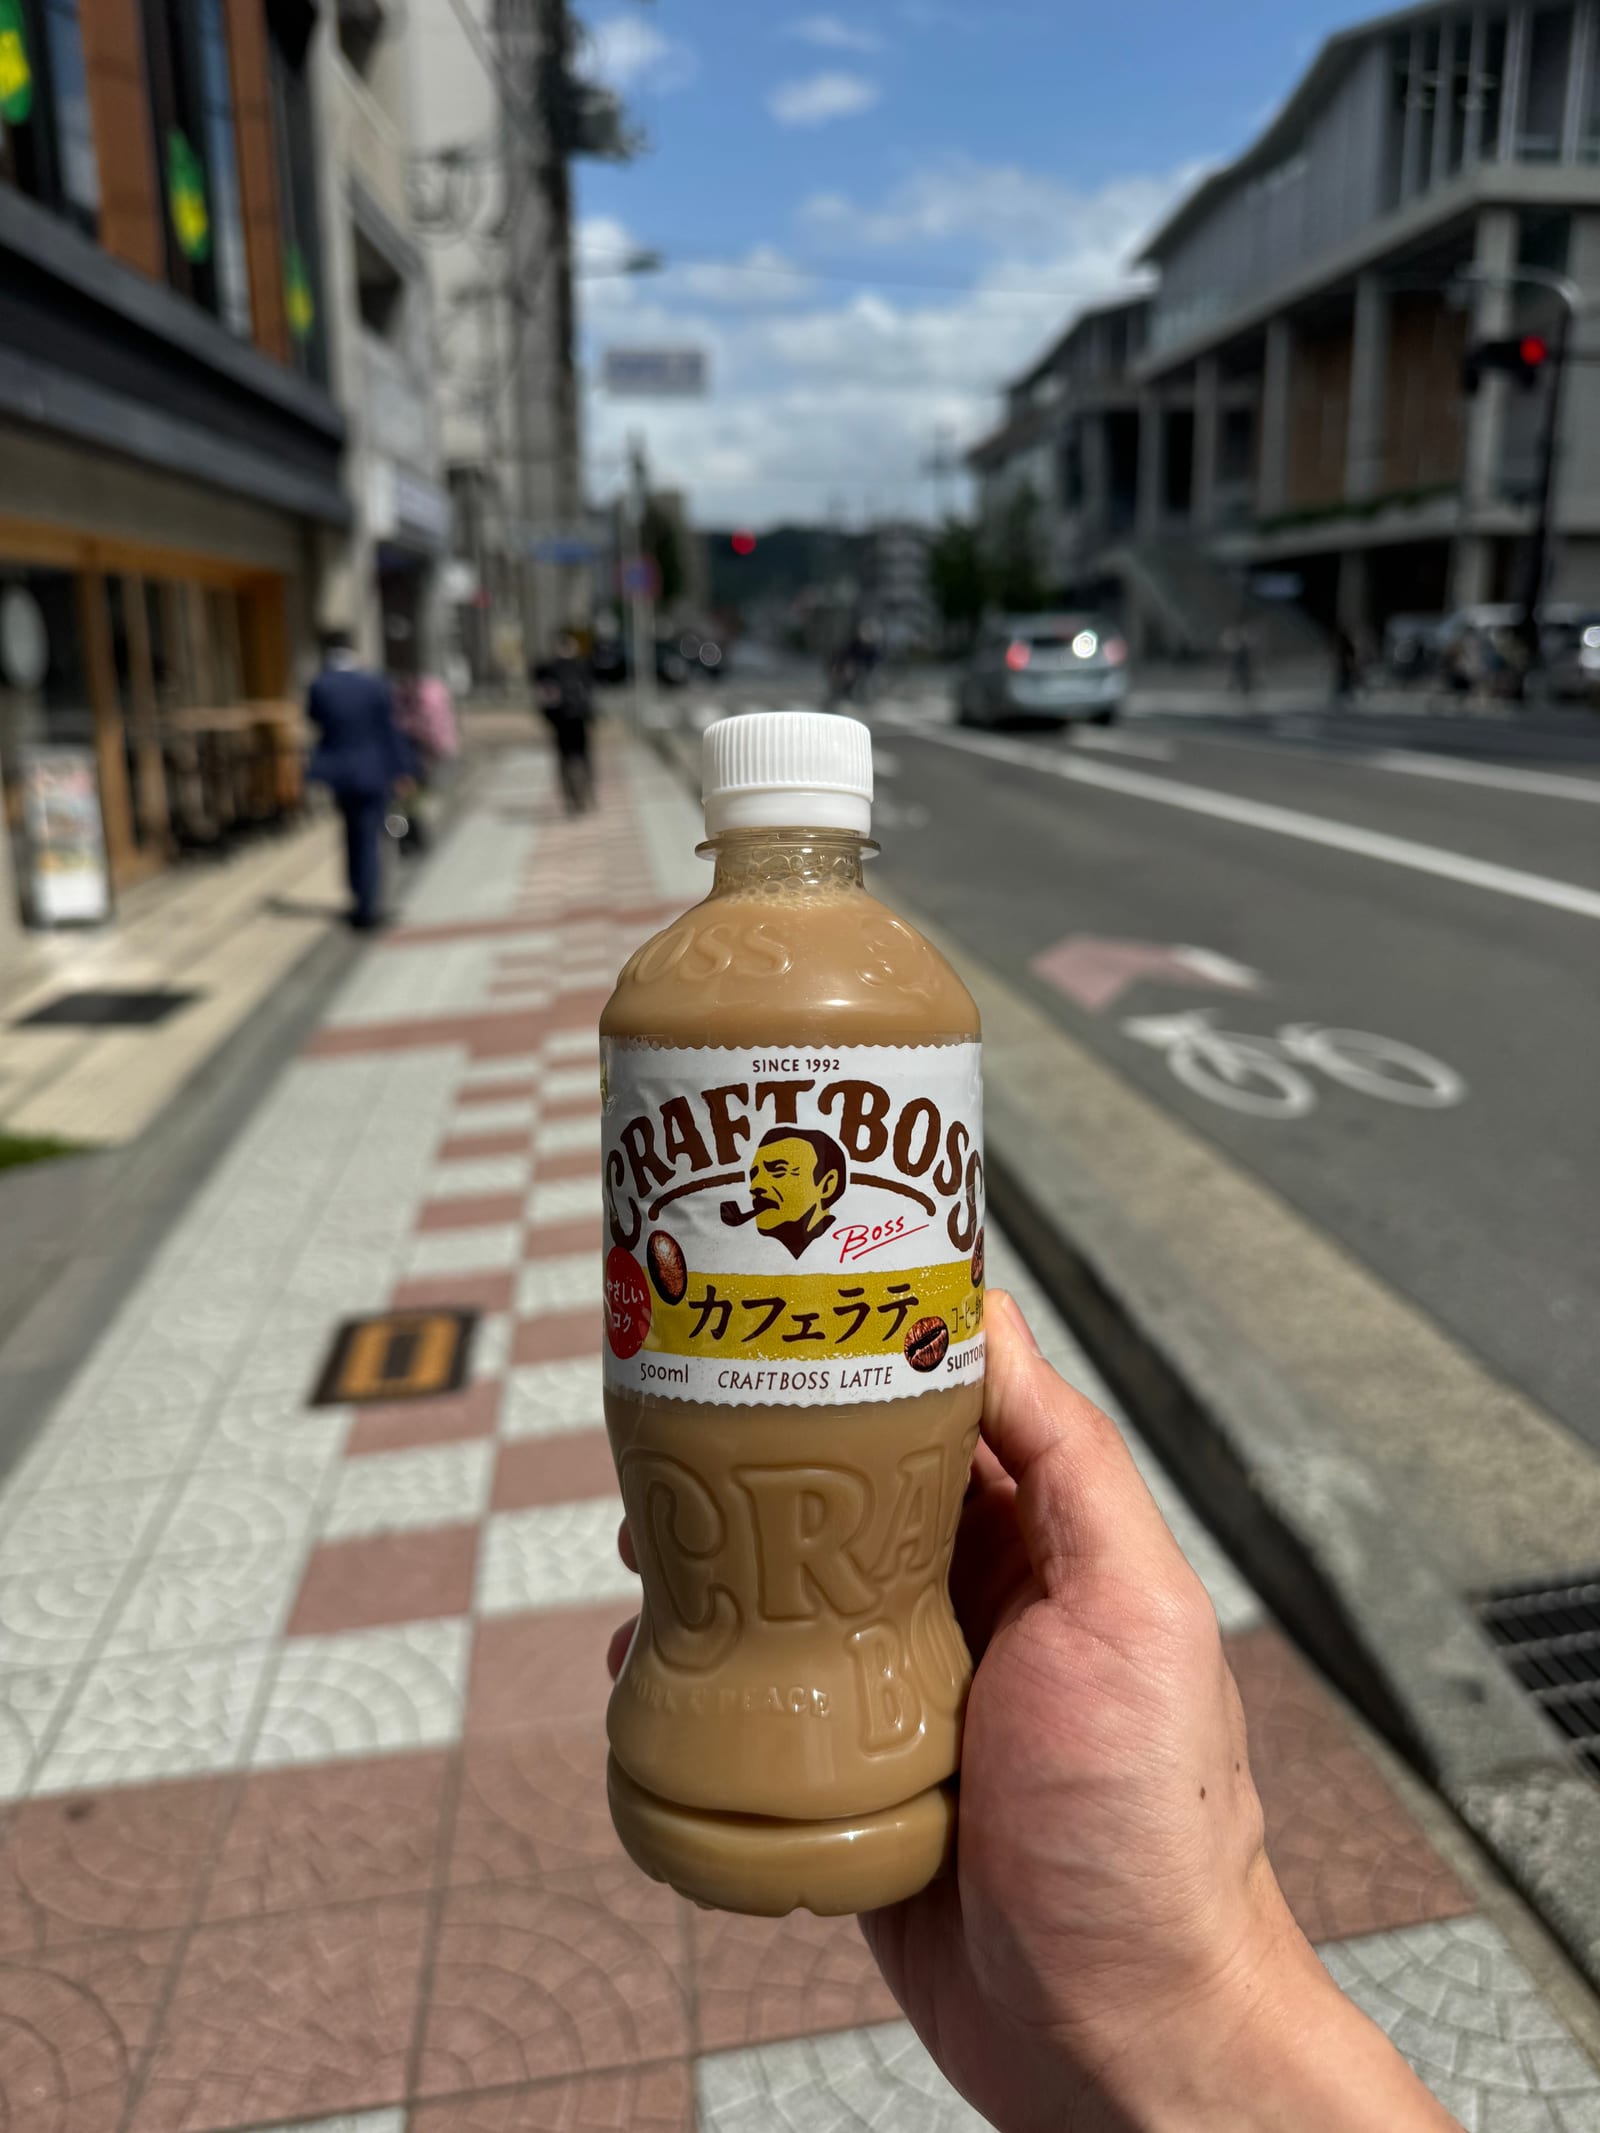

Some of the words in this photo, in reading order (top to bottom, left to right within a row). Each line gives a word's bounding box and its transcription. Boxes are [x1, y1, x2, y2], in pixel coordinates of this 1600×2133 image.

[752, 1059, 800, 1073] SINCE
[805, 1059, 840, 1073] 1992
[605, 1079, 815, 1252] CRAFT
[817, 1079, 984, 1252] BOSS
[606, 1279, 644, 1304] やさしい
[613, 1312, 632, 1334] コク
[688, 1283, 919, 1344] カフェラテ
[640, 1362, 689, 1384] 500ml
[717, 1369, 830, 1391] CRAFTBOSS
[840, 1366, 893, 1389] LATTE
